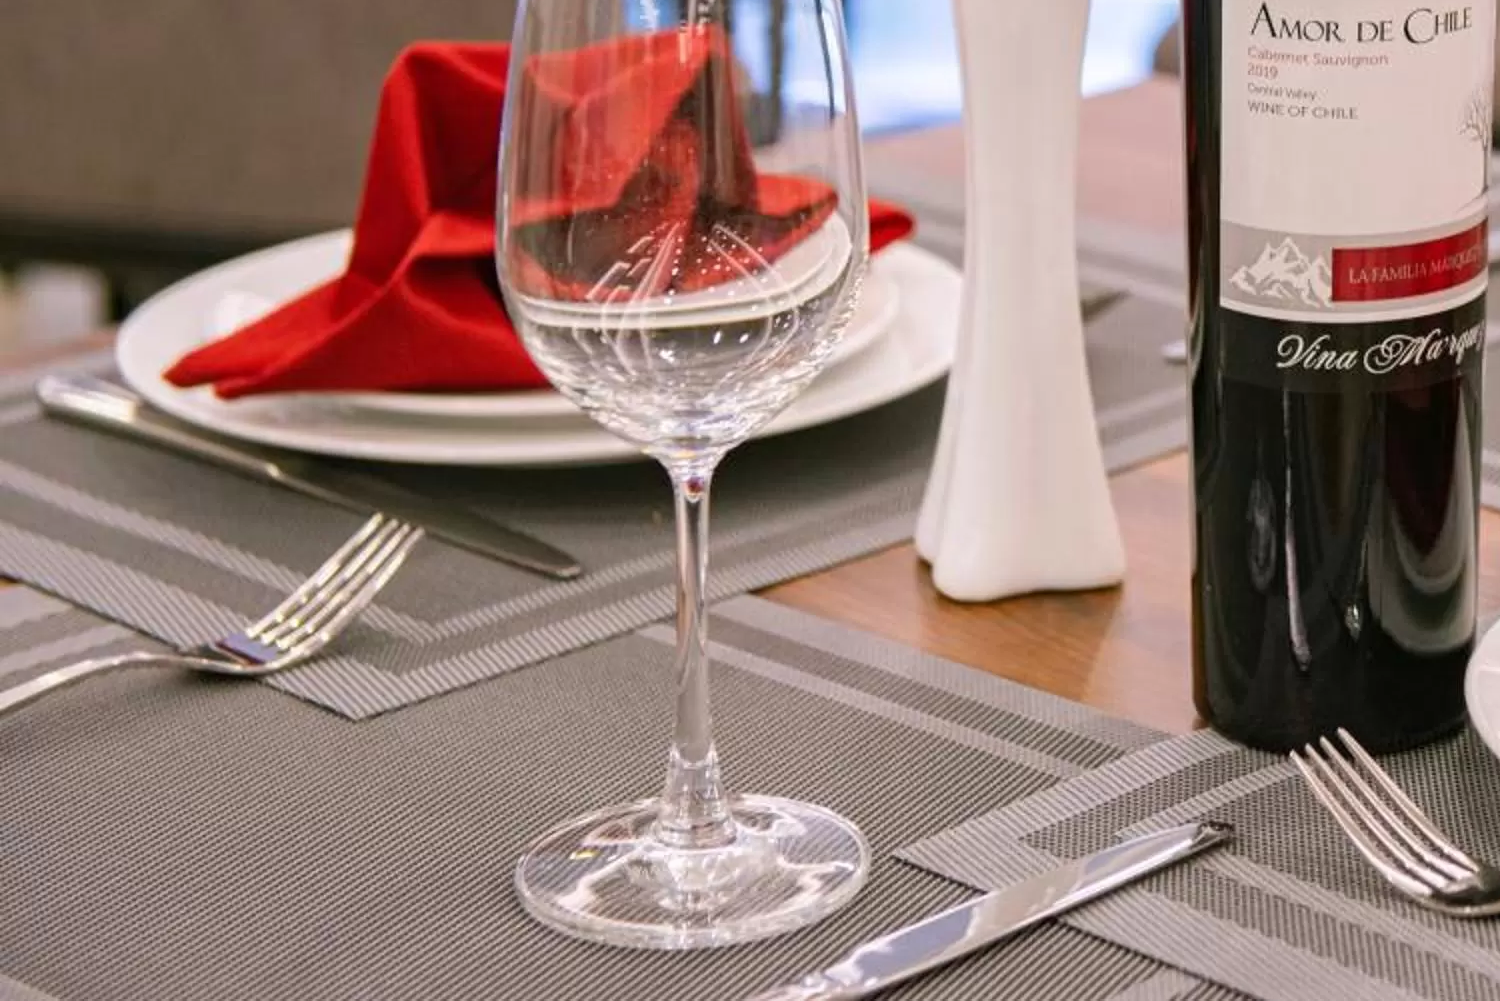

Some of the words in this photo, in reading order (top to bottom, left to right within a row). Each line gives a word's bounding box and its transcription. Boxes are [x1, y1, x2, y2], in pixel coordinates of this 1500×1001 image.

[1250, 0, 1346, 43] AMOR
[1356, 20, 1394, 43] DE
[1403, 7, 1473, 45] CHILE
[1247, 46, 1308, 66] Cabernet
[1313, 52, 1389, 69] Sauvignon
[1247, 62, 1278, 79] 2019
[1247, 100, 1285, 116] WINE
[1287, 105, 1307, 118] OF
[1311, 106, 1359, 120] CHILE
[1349, 266, 1369, 285] LA
[1371, 261, 1427, 284] FAMILIA
